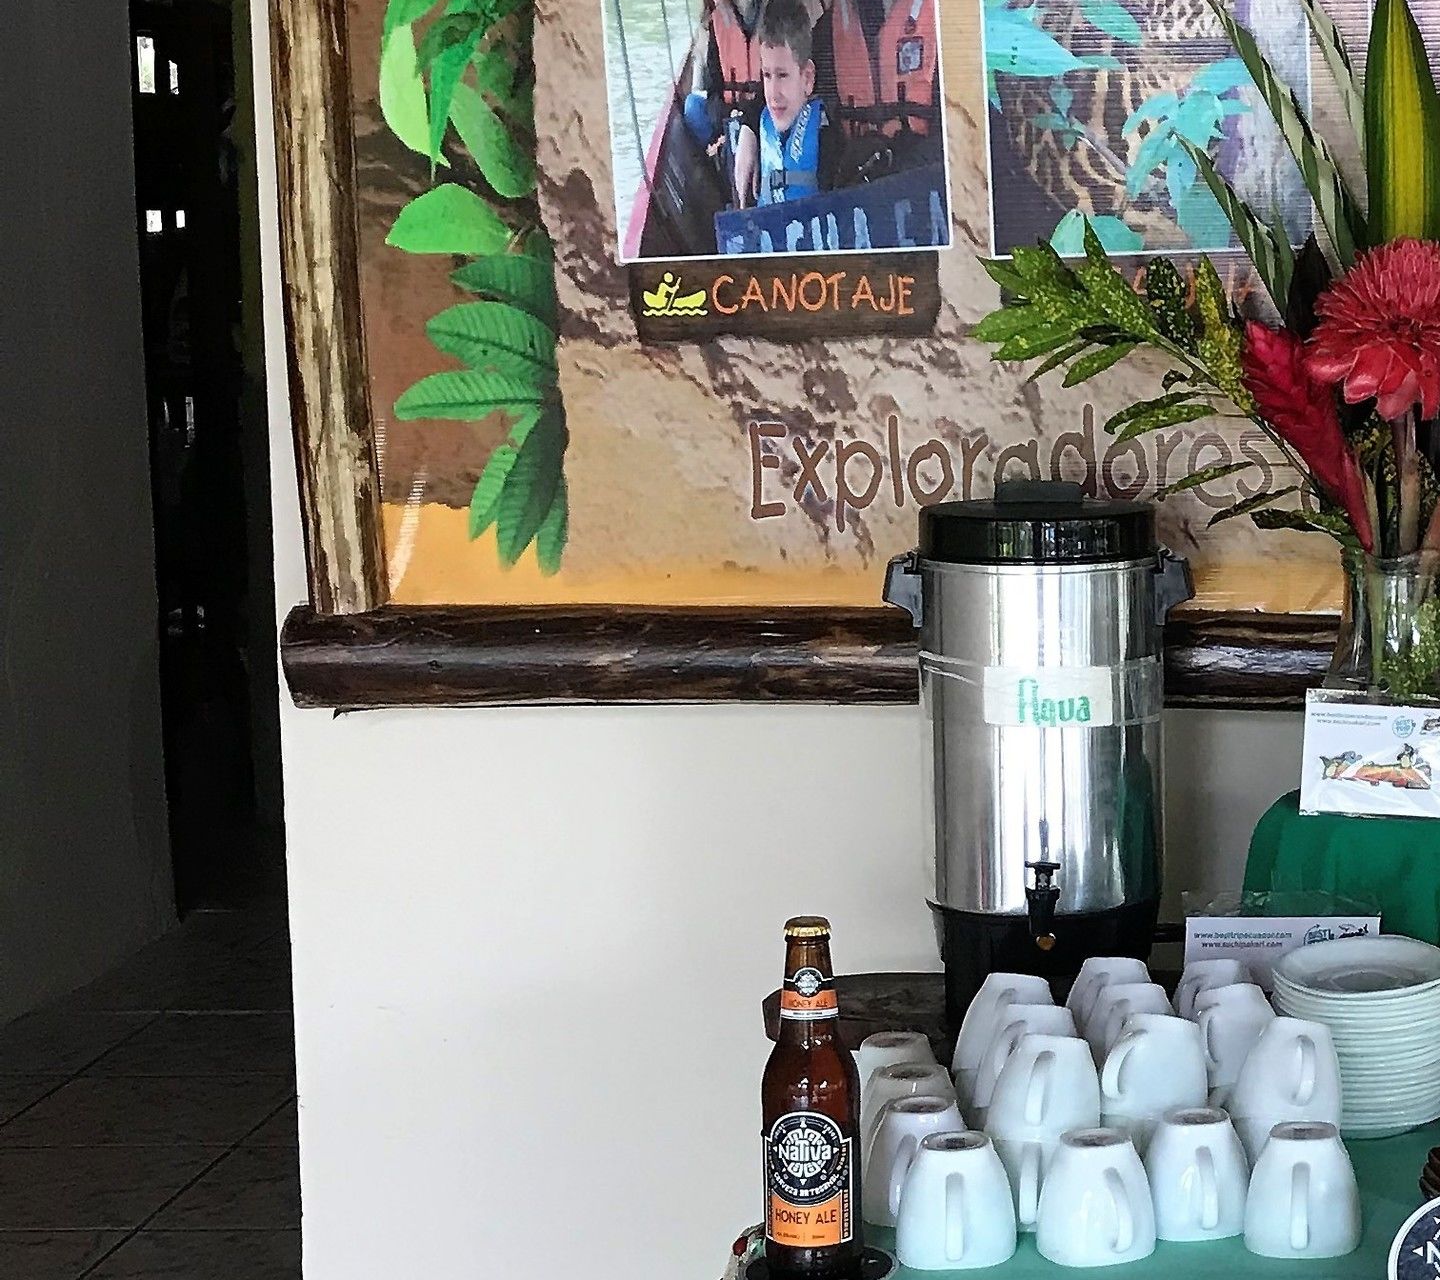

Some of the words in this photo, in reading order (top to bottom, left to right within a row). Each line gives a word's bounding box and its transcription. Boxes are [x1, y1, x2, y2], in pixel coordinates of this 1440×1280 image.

[711, 271, 916, 316] CANOTAJE
[774, 1208, 811, 1225] HONEY
[815, 1209, 838, 1225] ALE
